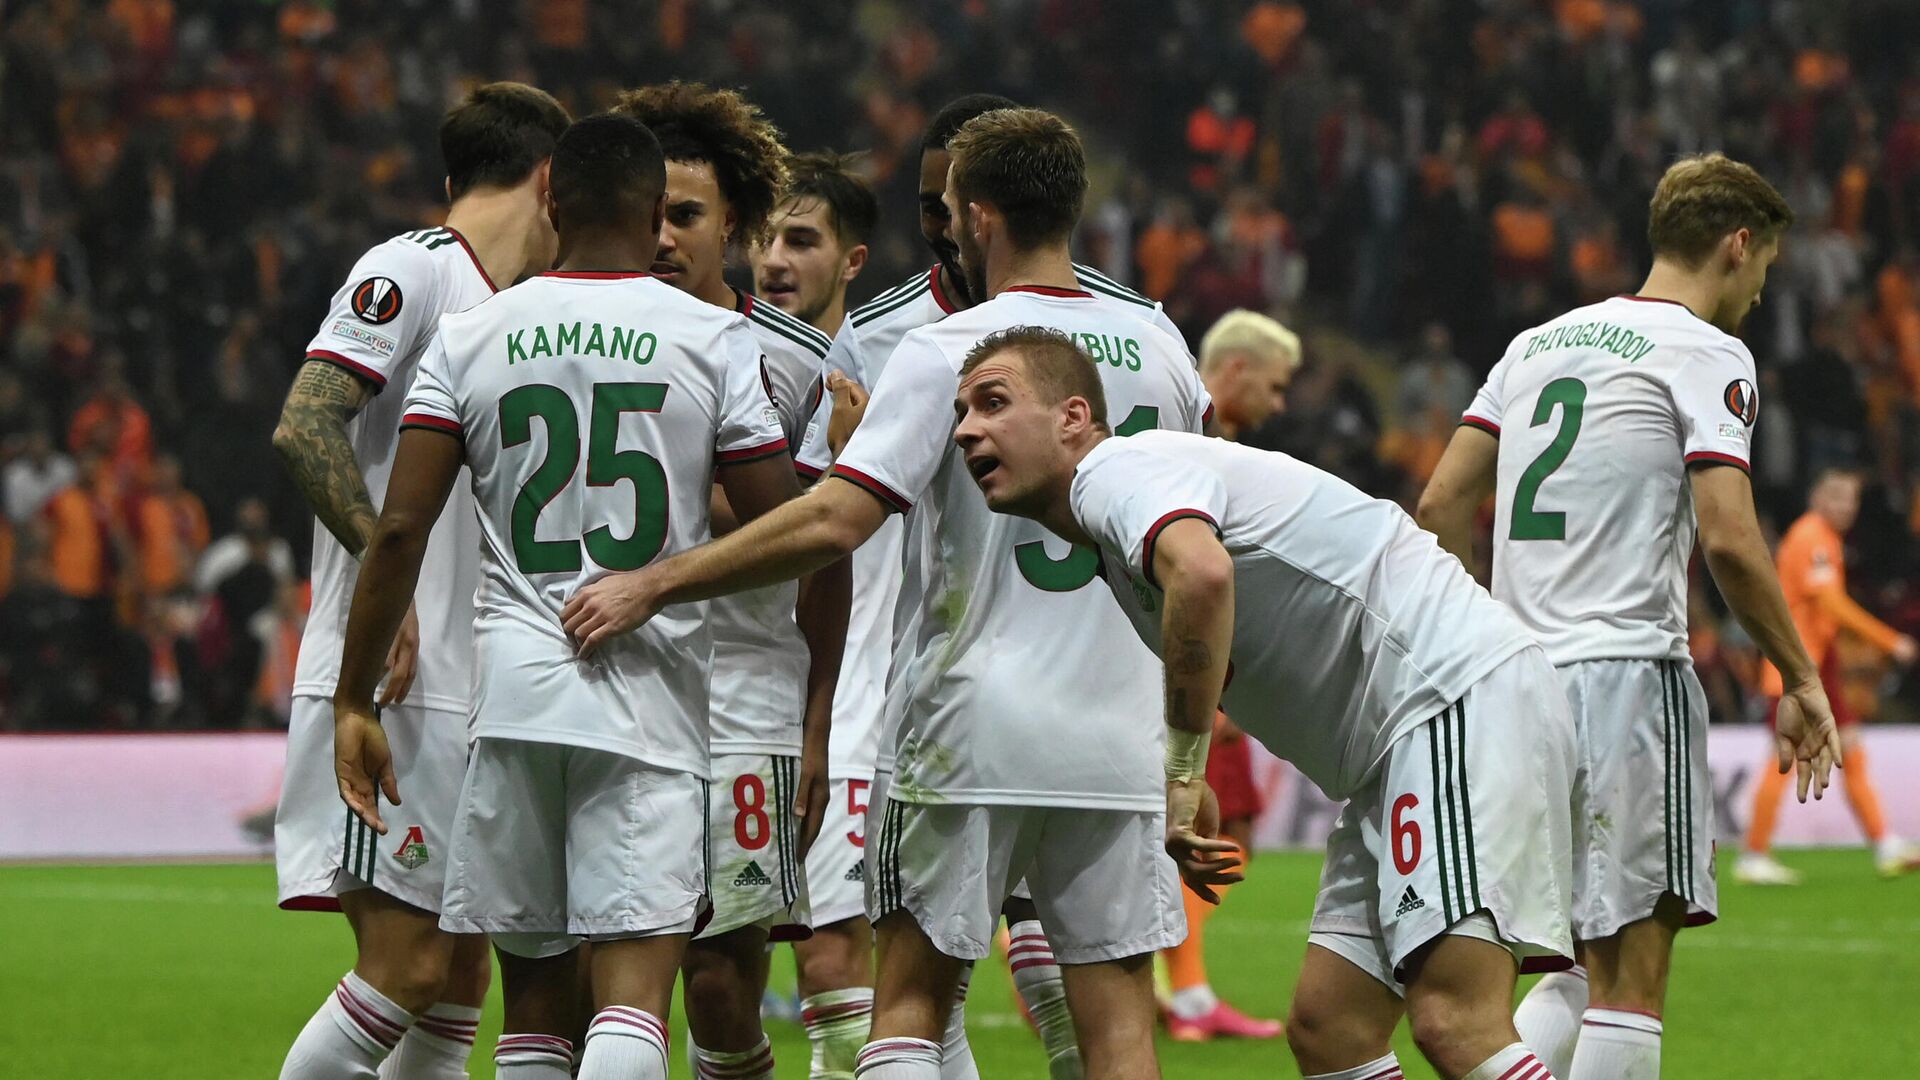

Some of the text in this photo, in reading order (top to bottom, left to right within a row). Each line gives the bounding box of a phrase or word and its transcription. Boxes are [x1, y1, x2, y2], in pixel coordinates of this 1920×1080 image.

[334, 324, 395, 353] FOUNDATION
[507, 321, 657, 366] KAMANO
[1523, 322, 1655, 363] ZHIVOGLYADOV
[498, 382, 670, 574] 25
[1508, 376, 1588, 541] 2
[733, 773, 771, 851] 8
[847, 779, 870, 848] 5
[1391, 793, 1422, 876] 6
[733, 875, 772, 887] adidas
[1395, 896, 1426, 918] adidas
